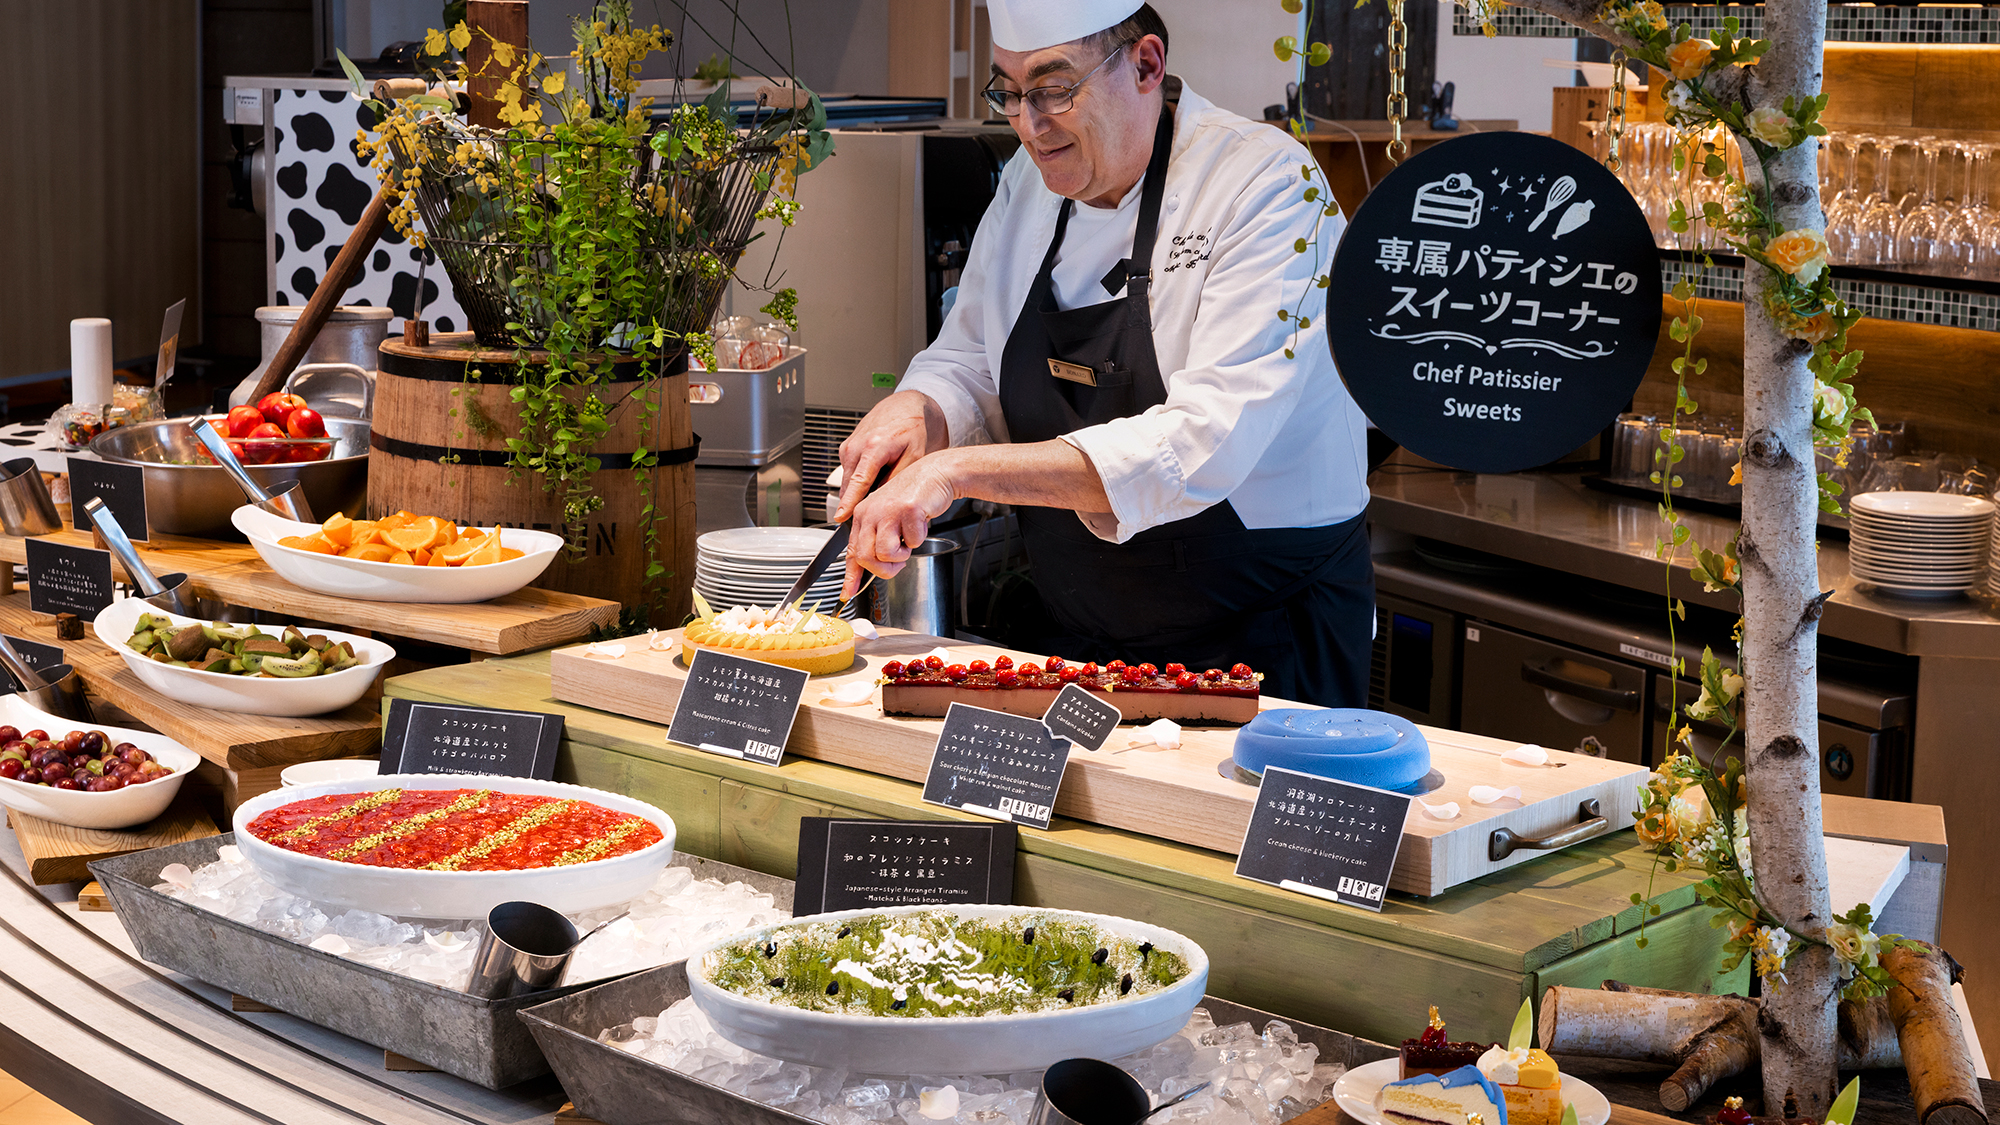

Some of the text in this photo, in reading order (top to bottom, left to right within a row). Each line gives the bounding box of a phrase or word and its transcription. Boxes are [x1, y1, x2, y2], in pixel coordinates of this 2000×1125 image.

[1374, 236, 1639, 295] 専属パティシエの
[1385, 285, 1621, 332] スイーツコーナー
[1412, 361, 1563, 392] Chef Patissier
[1443, 397, 1522, 422] Sweets
[698, 676, 787, 703] マスカルポーネクリームと
[712, 665, 781, 689] レモン薫る北海道産
[714, 692, 760, 708] 柑橘のガトー
[1070, 696, 1107, 721] アルコールが
[442, 718, 507, 732] スコップケーキ
[721, 716, 737, 726] cream
[758, 726, 771, 734] cake
[973, 723, 1042, 744] サワーチェリーと
[1056, 714, 1097, 741] Contains alcohol
[433, 735, 508, 750] 北海道産ミルクと
[952, 734, 1056, 760] ベルギーショコラのムース
[943, 744, 1057, 773] ホワイトラムとくるみのガトー
[940, 760, 953, 770] Sour
[953, 764, 972, 776] cherry
[1000, 774, 1028, 786] chocolate
[1030, 782, 1052, 792] mousse
[959, 774, 975, 784] White
[992, 782, 1011, 792] walnut
[1012, 786, 1026, 795] cake
[1286, 787, 1376, 814] 洞爺湖フロマージュ
[1267, 800, 1387, 834] 北海道産クリームチーズと
[869, 834, 950, 846] スコップケーキ
[1274, 816, 1373, 844] ブルーベリーのガトー
[843, 852, 974, 866] 和のアレンジティラミス
[1267, 837, 1288, 849] Cream
[1288, 842, 1313, 854] cheese
[1318, 849, 1350, 864] blueberry
[1350, 856, 1368, 867] cake
[844, 884, 969, 896] Japanese-style Arranged Tiramisu
[902, 895, 922, 903] Black
